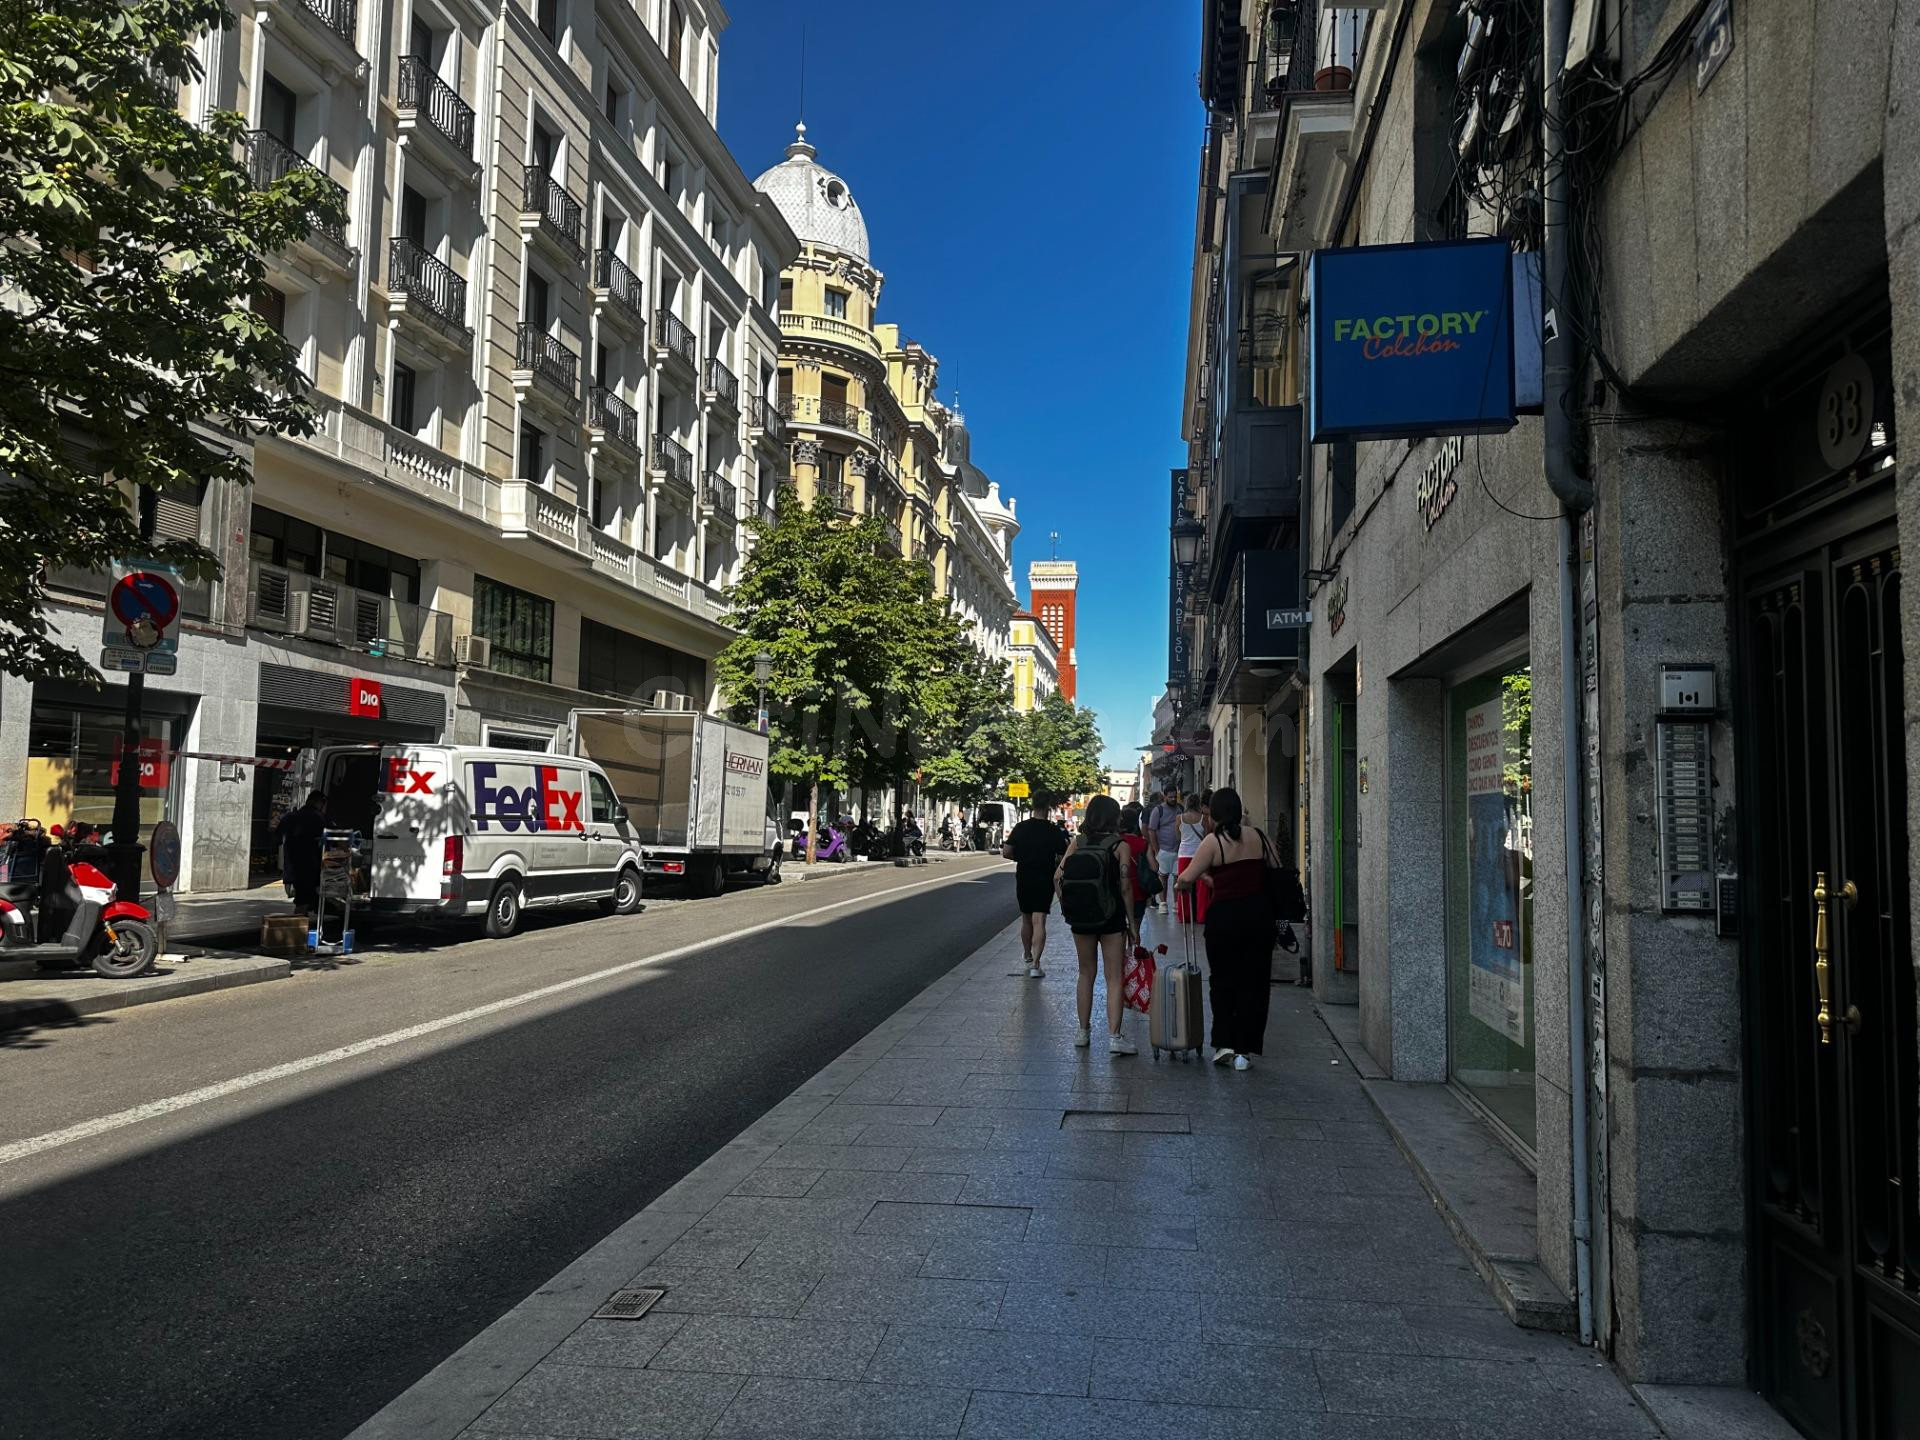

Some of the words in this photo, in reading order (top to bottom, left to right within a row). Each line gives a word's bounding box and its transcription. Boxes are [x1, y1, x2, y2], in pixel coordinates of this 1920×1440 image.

[1334, 311, 1484, 342] FACTORY
[1825, 380, 1860, 447] 33
[1416, 436, 1463, 512] FACTORY
[1271, 612, 1304, 626] ATM
[1174, 637, 1183, 662] SOL
[473, 762, 585, 833] FedEx
